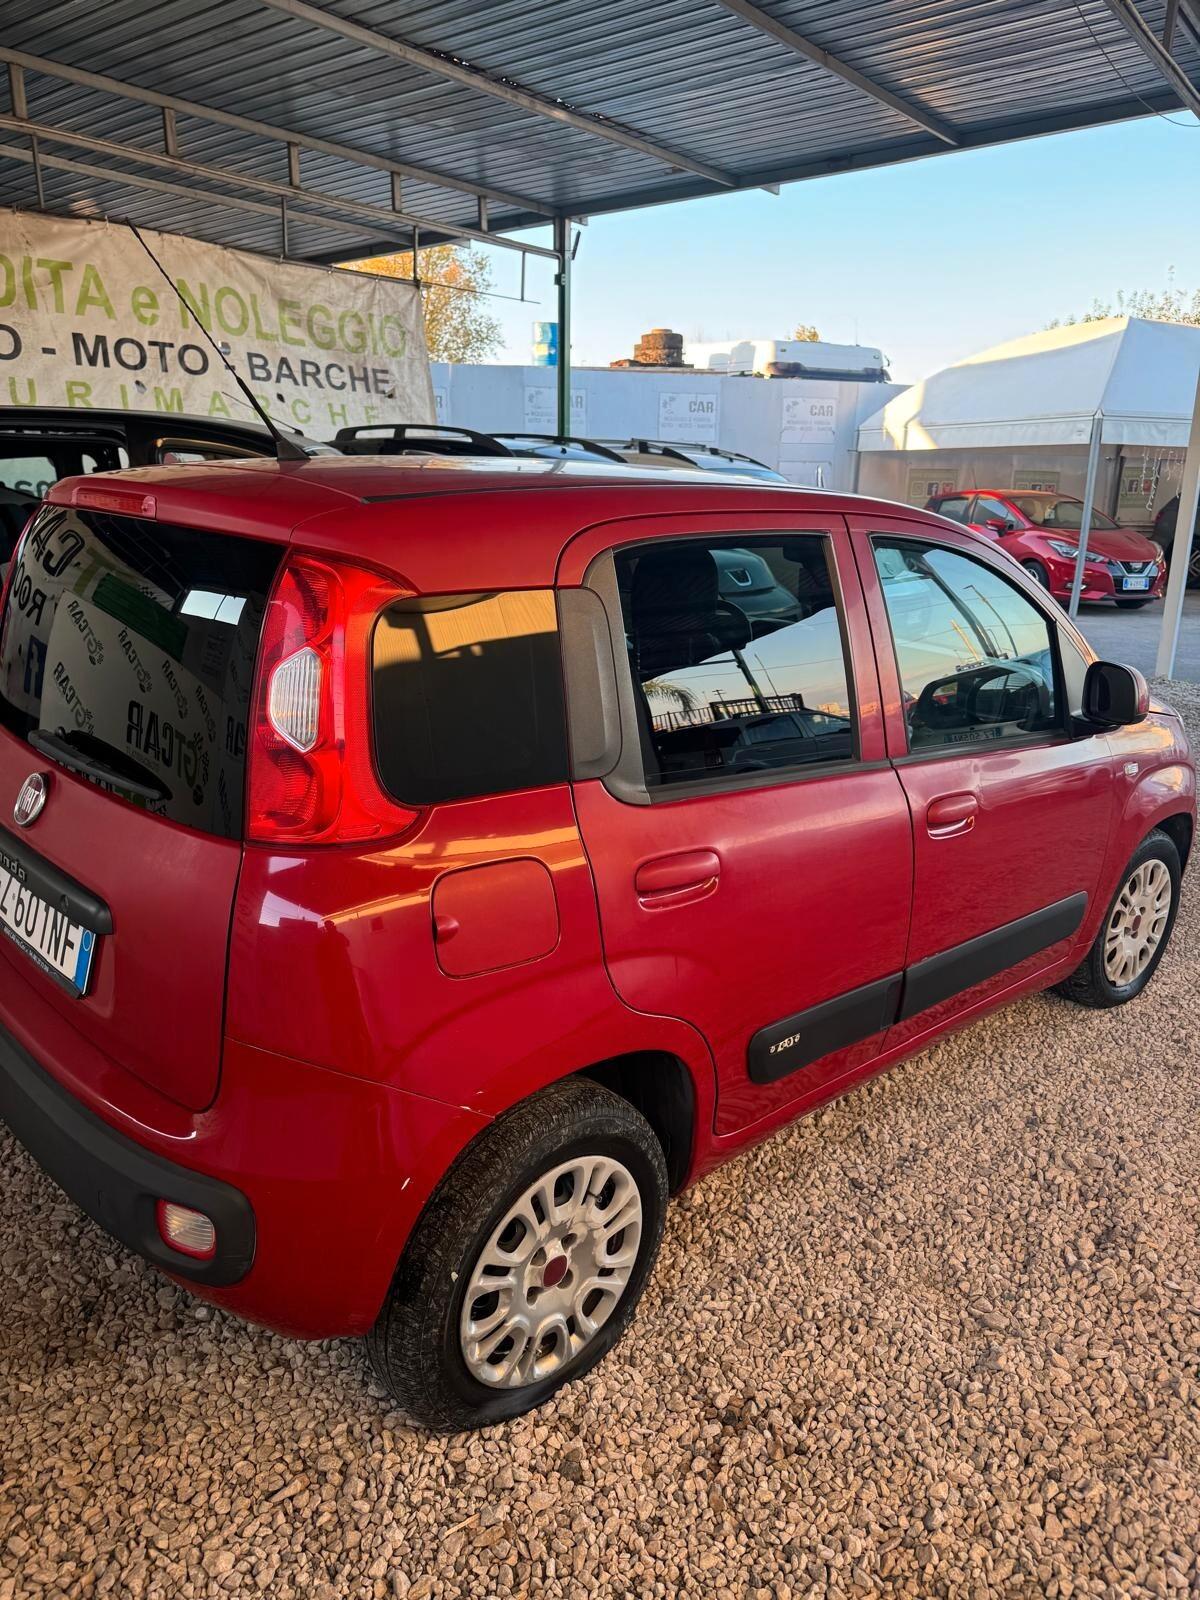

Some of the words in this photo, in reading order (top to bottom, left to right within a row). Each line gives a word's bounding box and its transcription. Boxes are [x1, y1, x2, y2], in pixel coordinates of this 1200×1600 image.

[131, 286, 160, 326] e
[176, 278, 407, 358] NOLEGGIO
[71, 332, 209, 376] MOTO
[247, 351, 392, 395] BARCHE
